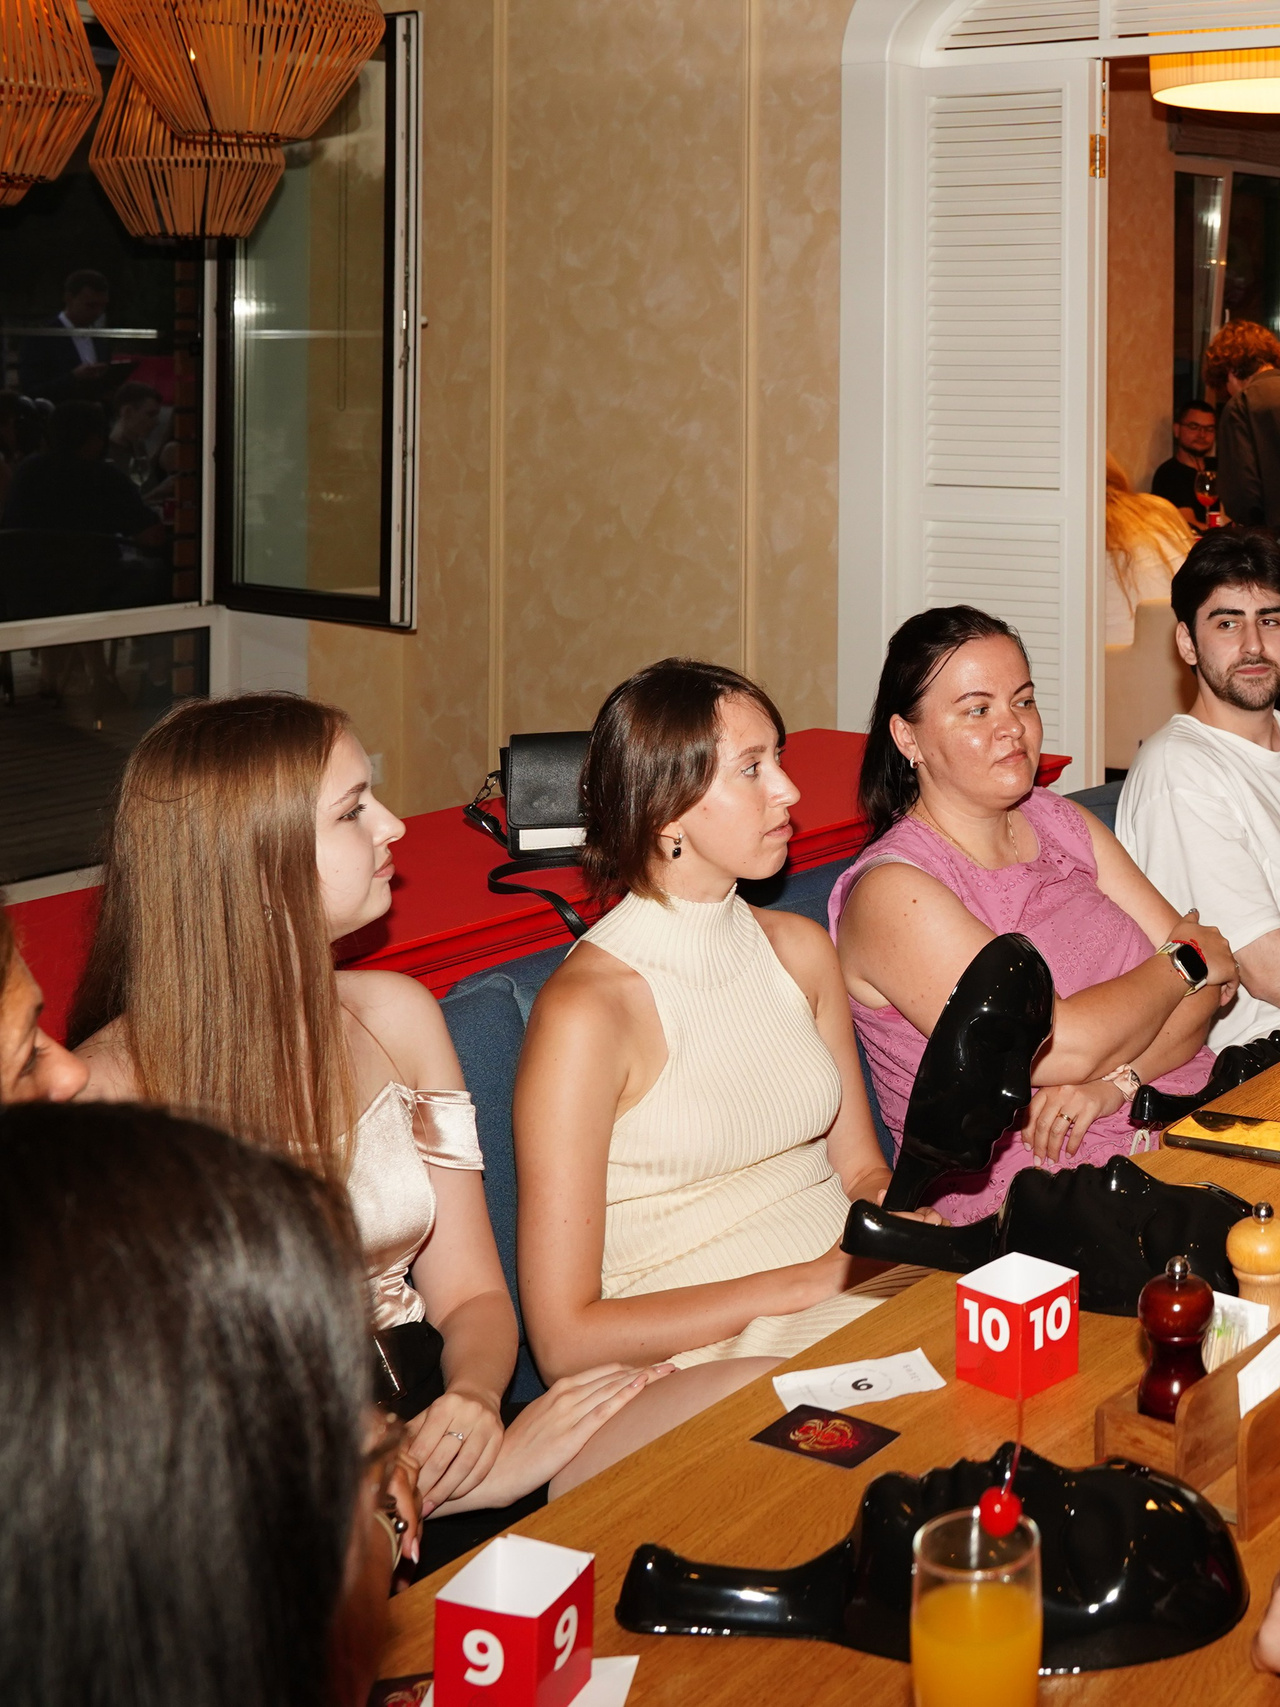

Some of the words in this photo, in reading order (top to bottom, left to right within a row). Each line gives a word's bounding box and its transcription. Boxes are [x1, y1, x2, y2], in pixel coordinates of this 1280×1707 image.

[962, 1297, 1011, 1354] 10
[1028, 1294, 1072, 1351] 10
[462, 1628, 505, 1687] 9
[553, 1604, 579, 1673] 9
